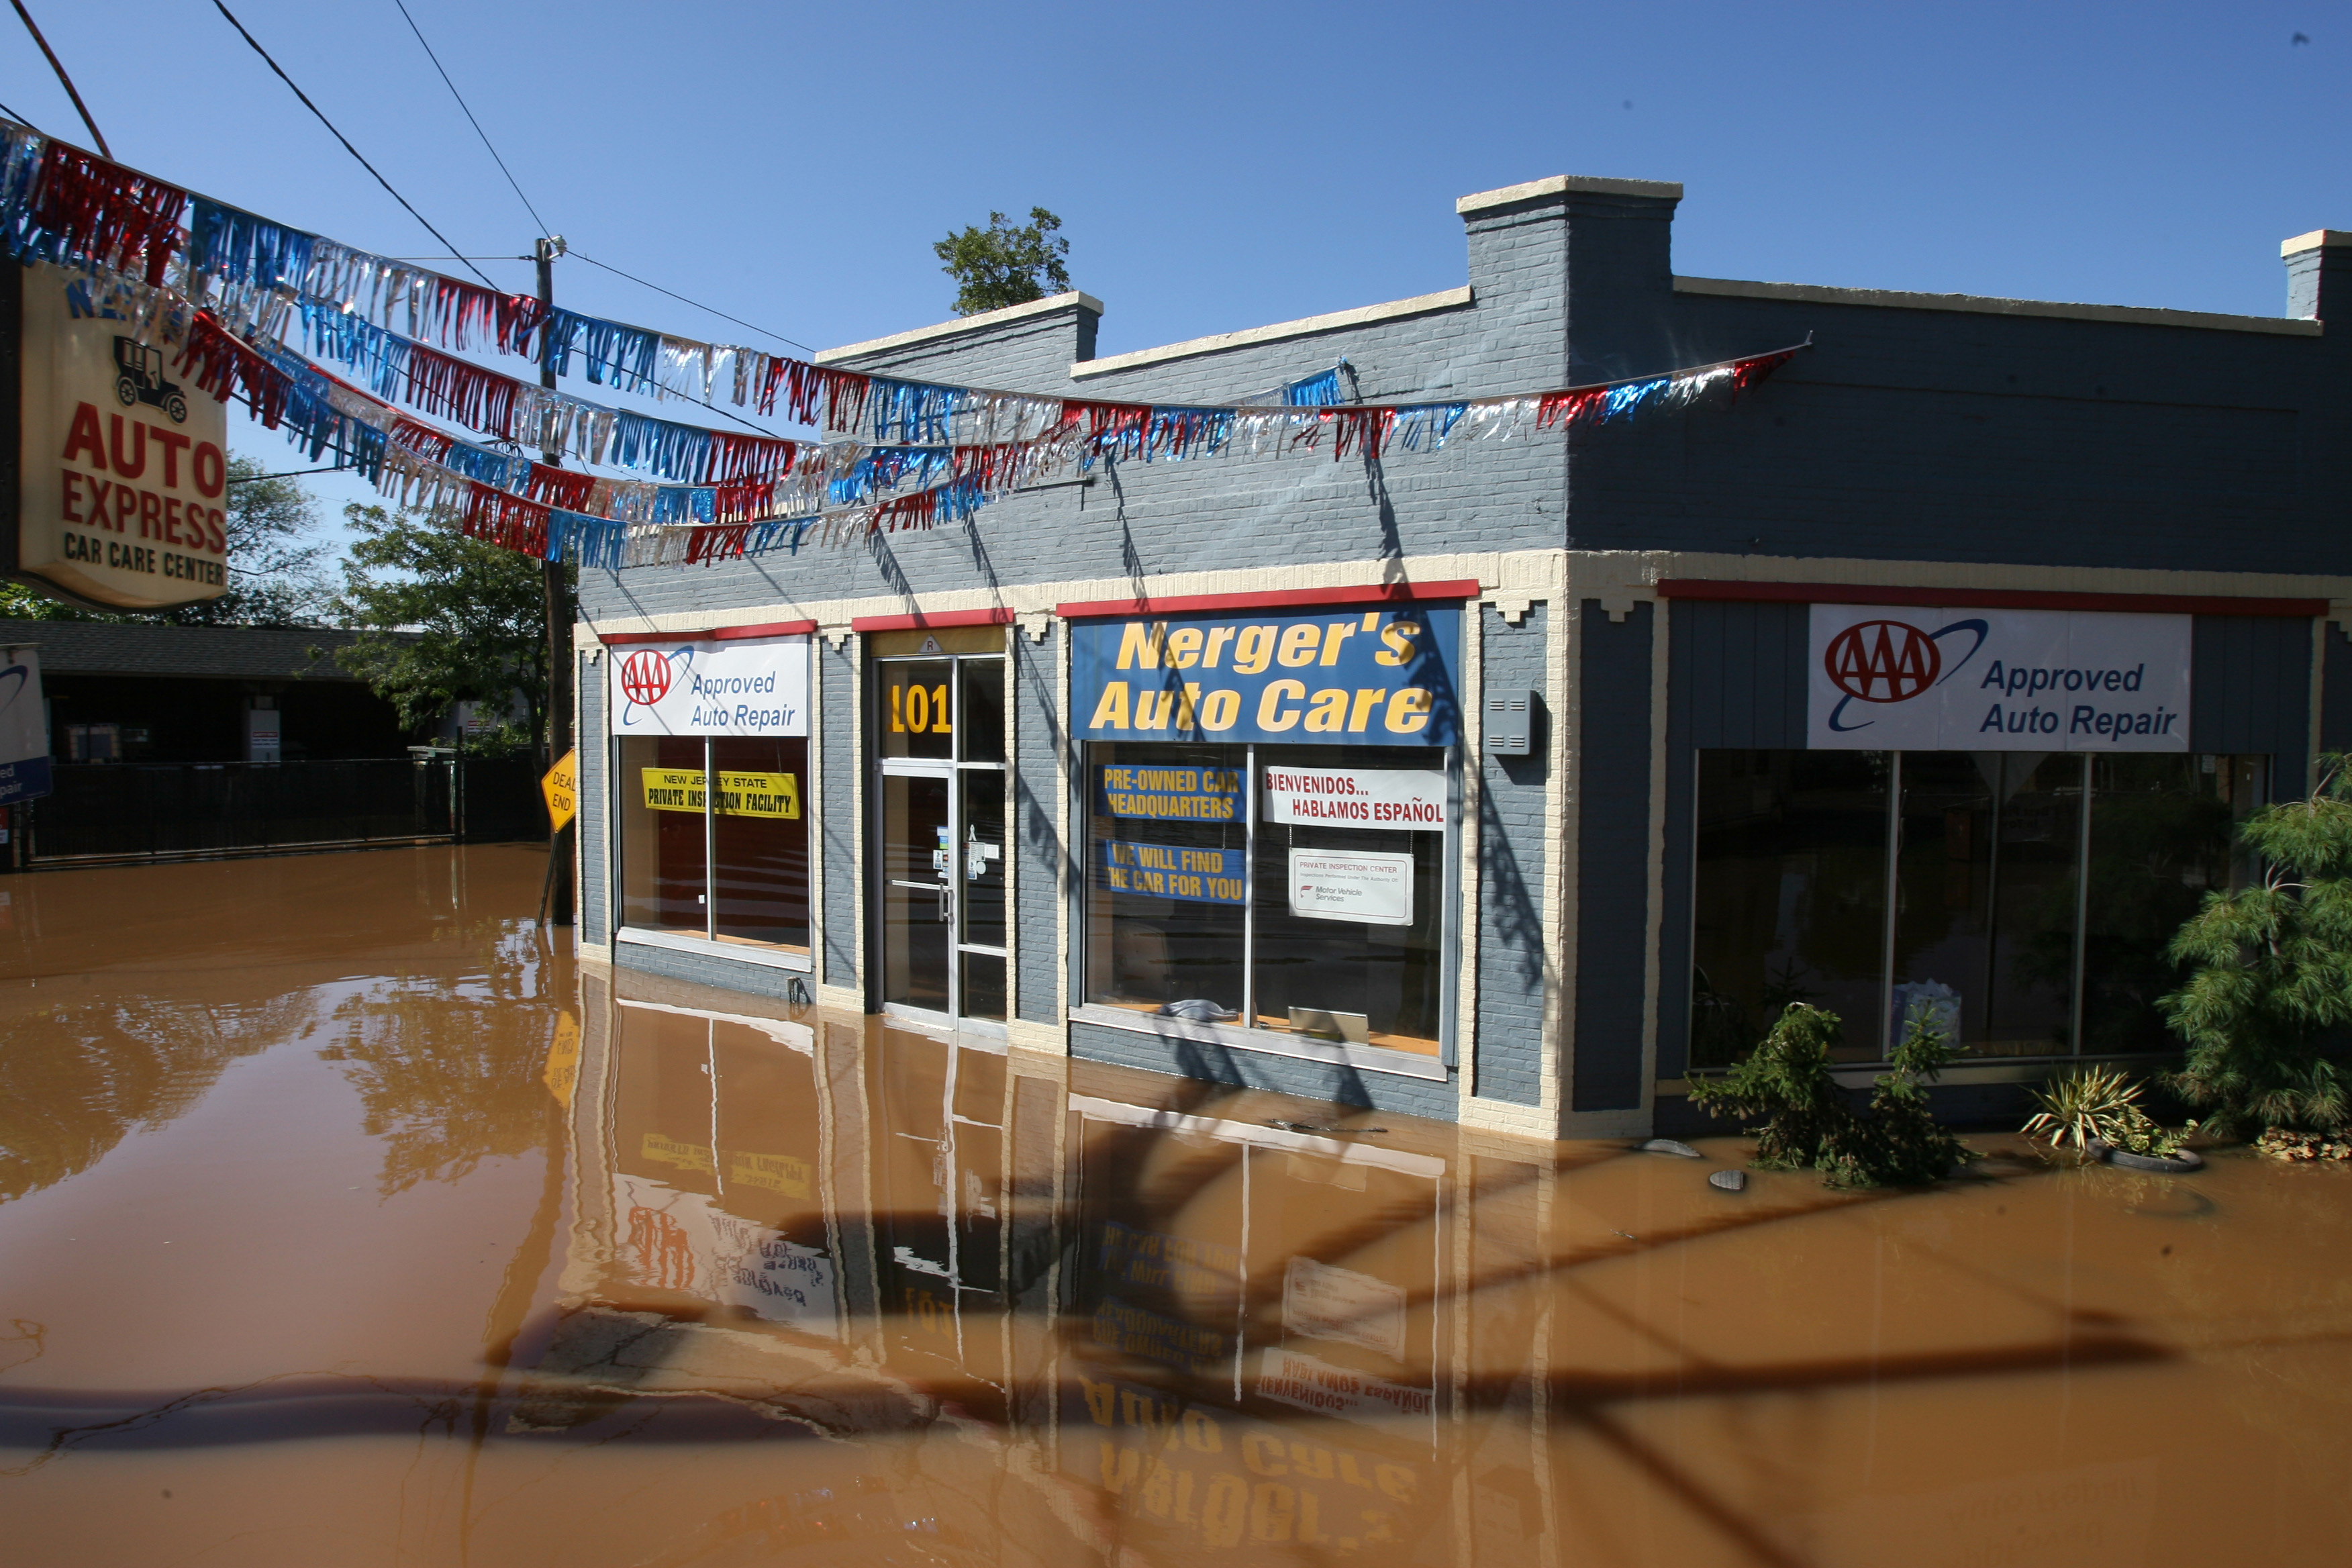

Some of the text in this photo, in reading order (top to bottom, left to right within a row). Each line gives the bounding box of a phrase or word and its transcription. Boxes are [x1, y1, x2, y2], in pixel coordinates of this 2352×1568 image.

[62, 401, 225, 497] AUTO
[61, 468, 226, 554] EXPRESS
[64, 532, 224, 586] CAR CARE CENTER
[927, 640, 934, 651] R
[1116, 612, 1420, 674] Nerger's
[1824, 620, 1941, 703] AAA
[622, 649, 671, 705] AAA
[690, 671, 776, 700] Approved
[1979, 660, 2145, 697] Approved
[690, 703, 795, 732] Auto Repair
[886, 684, 951, 733] 101
[1089, 679, 1432, 734] Auto Care
[1979, 703, 2176, 742] Auto Repair
[664, 775, 687, 785] NEW
[734, 777, 767, 789] STATE
[1104, 769, 1239, 793] PRE-OWNED CAR
[1266, 773, 1369, 795] BIENVENIDOS...
[552, 793, 571, 812] END
[648, 788, 684, 805] PRIVATE
[746, 793, 791, 813] FACILITY
[1108, 793, 1234, 819] HEADQUARTERS
[1292, 797, 1444, 822] HABLAMOS ESPAÑOL
[1112, 843, 1224, 873] WE WILL FIND
[1329, 863, 1367, 871] INSPECTION
[1370, 865, 1398, 873] CENTER
[1133, 870, 1165, 893] CAR
[1168, 875, 1202, 897] FOR
[1206, 877, 1242, 900] YOU
[1316, 893, 1344, 901] Services
[1338, 887, 1363, 896] Vehicle
